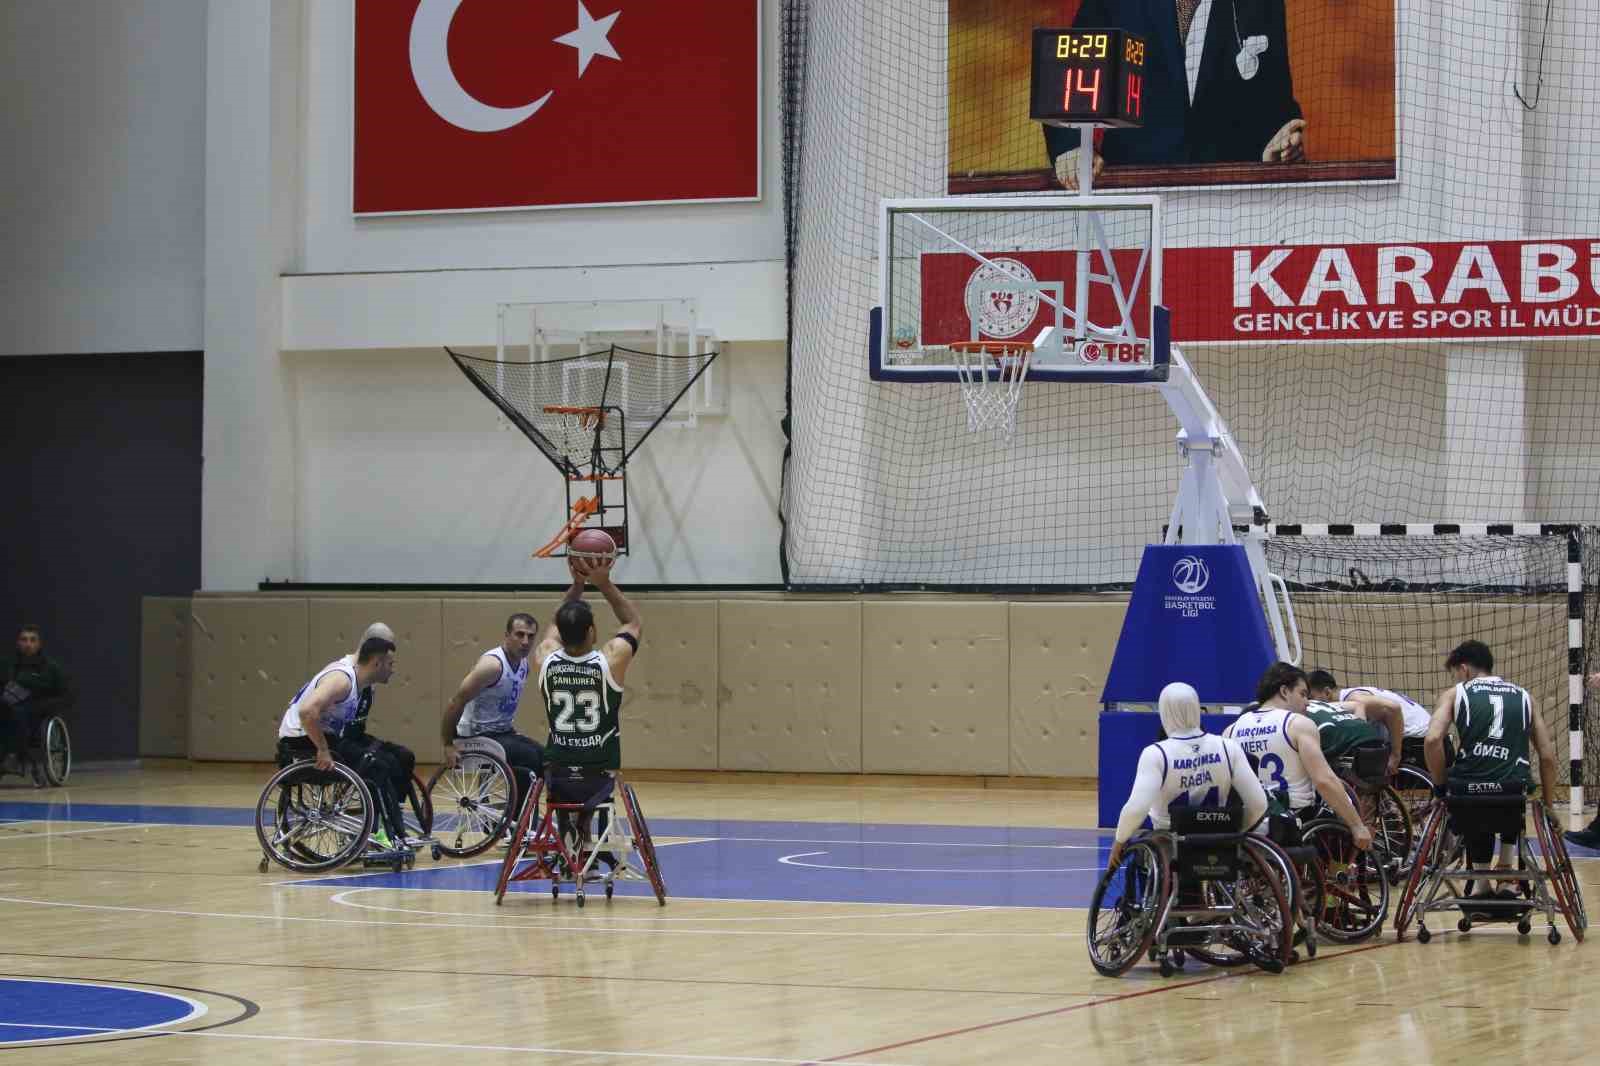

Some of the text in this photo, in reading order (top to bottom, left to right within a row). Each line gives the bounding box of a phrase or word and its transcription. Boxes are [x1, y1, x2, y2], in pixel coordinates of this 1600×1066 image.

[1056, 34, 1108, 58] 8:29
[1125, 38, 1144, 66] 8:29
[1063, 67, 1101, 112] 14
[1126, 71, 1142, 118] 14
[1232, 242, 1600, 308] KARAB
[1233, 307, 1361, 335] GENÇLİK
[1366, 310, 1404, 330] VE
[1412, 309, 1492, 329] SPOR
[1500, 305, 1526, 327] İL
[1103, 343, 1146, 363] TBF
[1164, 601, 1217, 609] BASKETBOL
[552, 689, 601, 733] 23
[1487, 694, 1505, 740] 1
[1240, 739, 1269, 753] MERT
[1472, 742, 1510, 761] ÖMER
[1467, 782, 1504, 792] EXTRA
[1196, 811, 1231, 822] EXTRA
